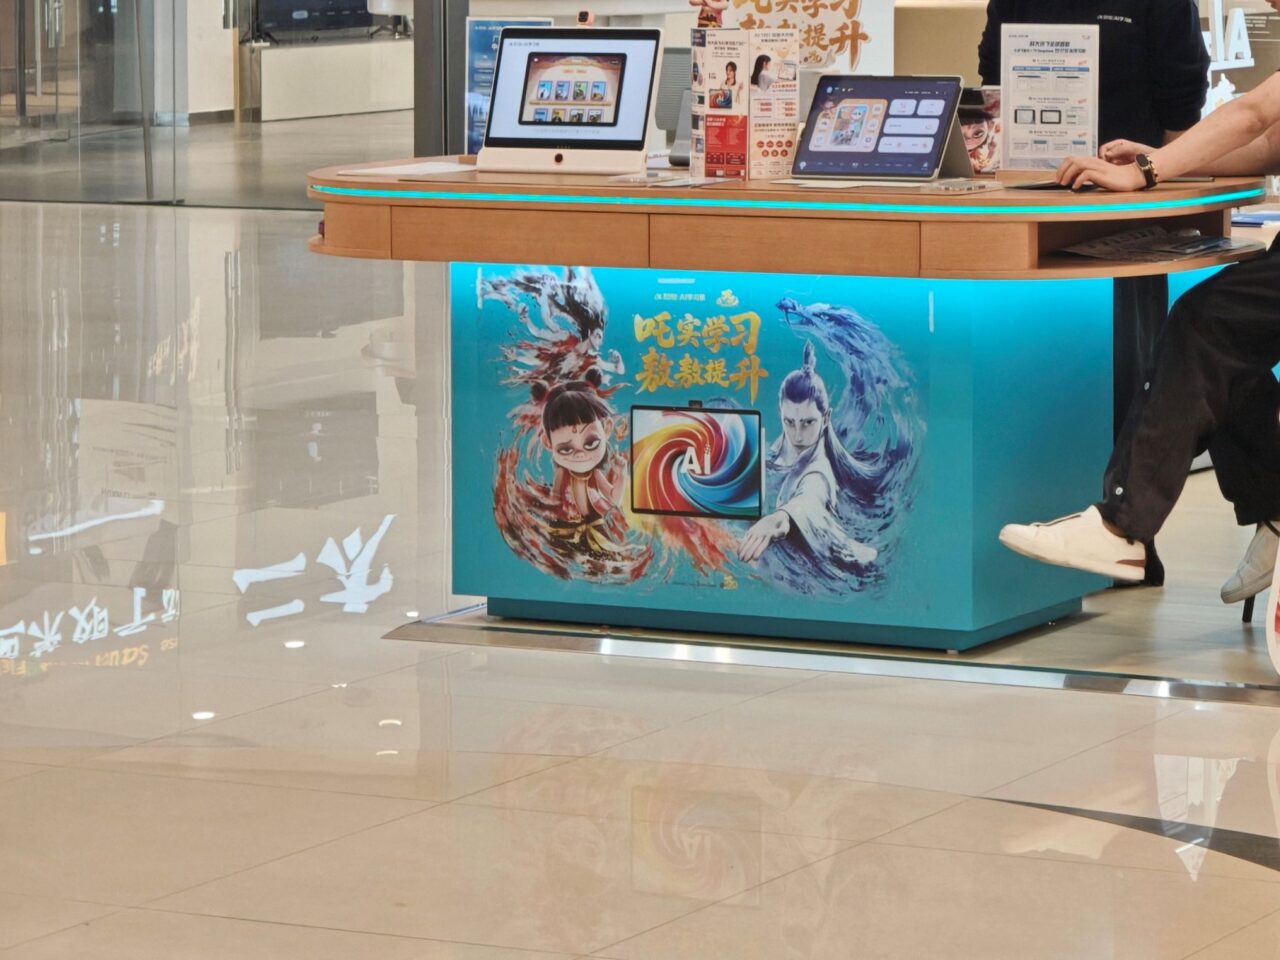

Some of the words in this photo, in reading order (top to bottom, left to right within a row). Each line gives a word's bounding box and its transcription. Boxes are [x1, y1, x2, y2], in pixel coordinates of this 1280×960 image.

[739, 14, 870, 70] 提升
[634, 311, 761, 355] 吒实学习
[635, 347, 768, 406] 敖敖提升
